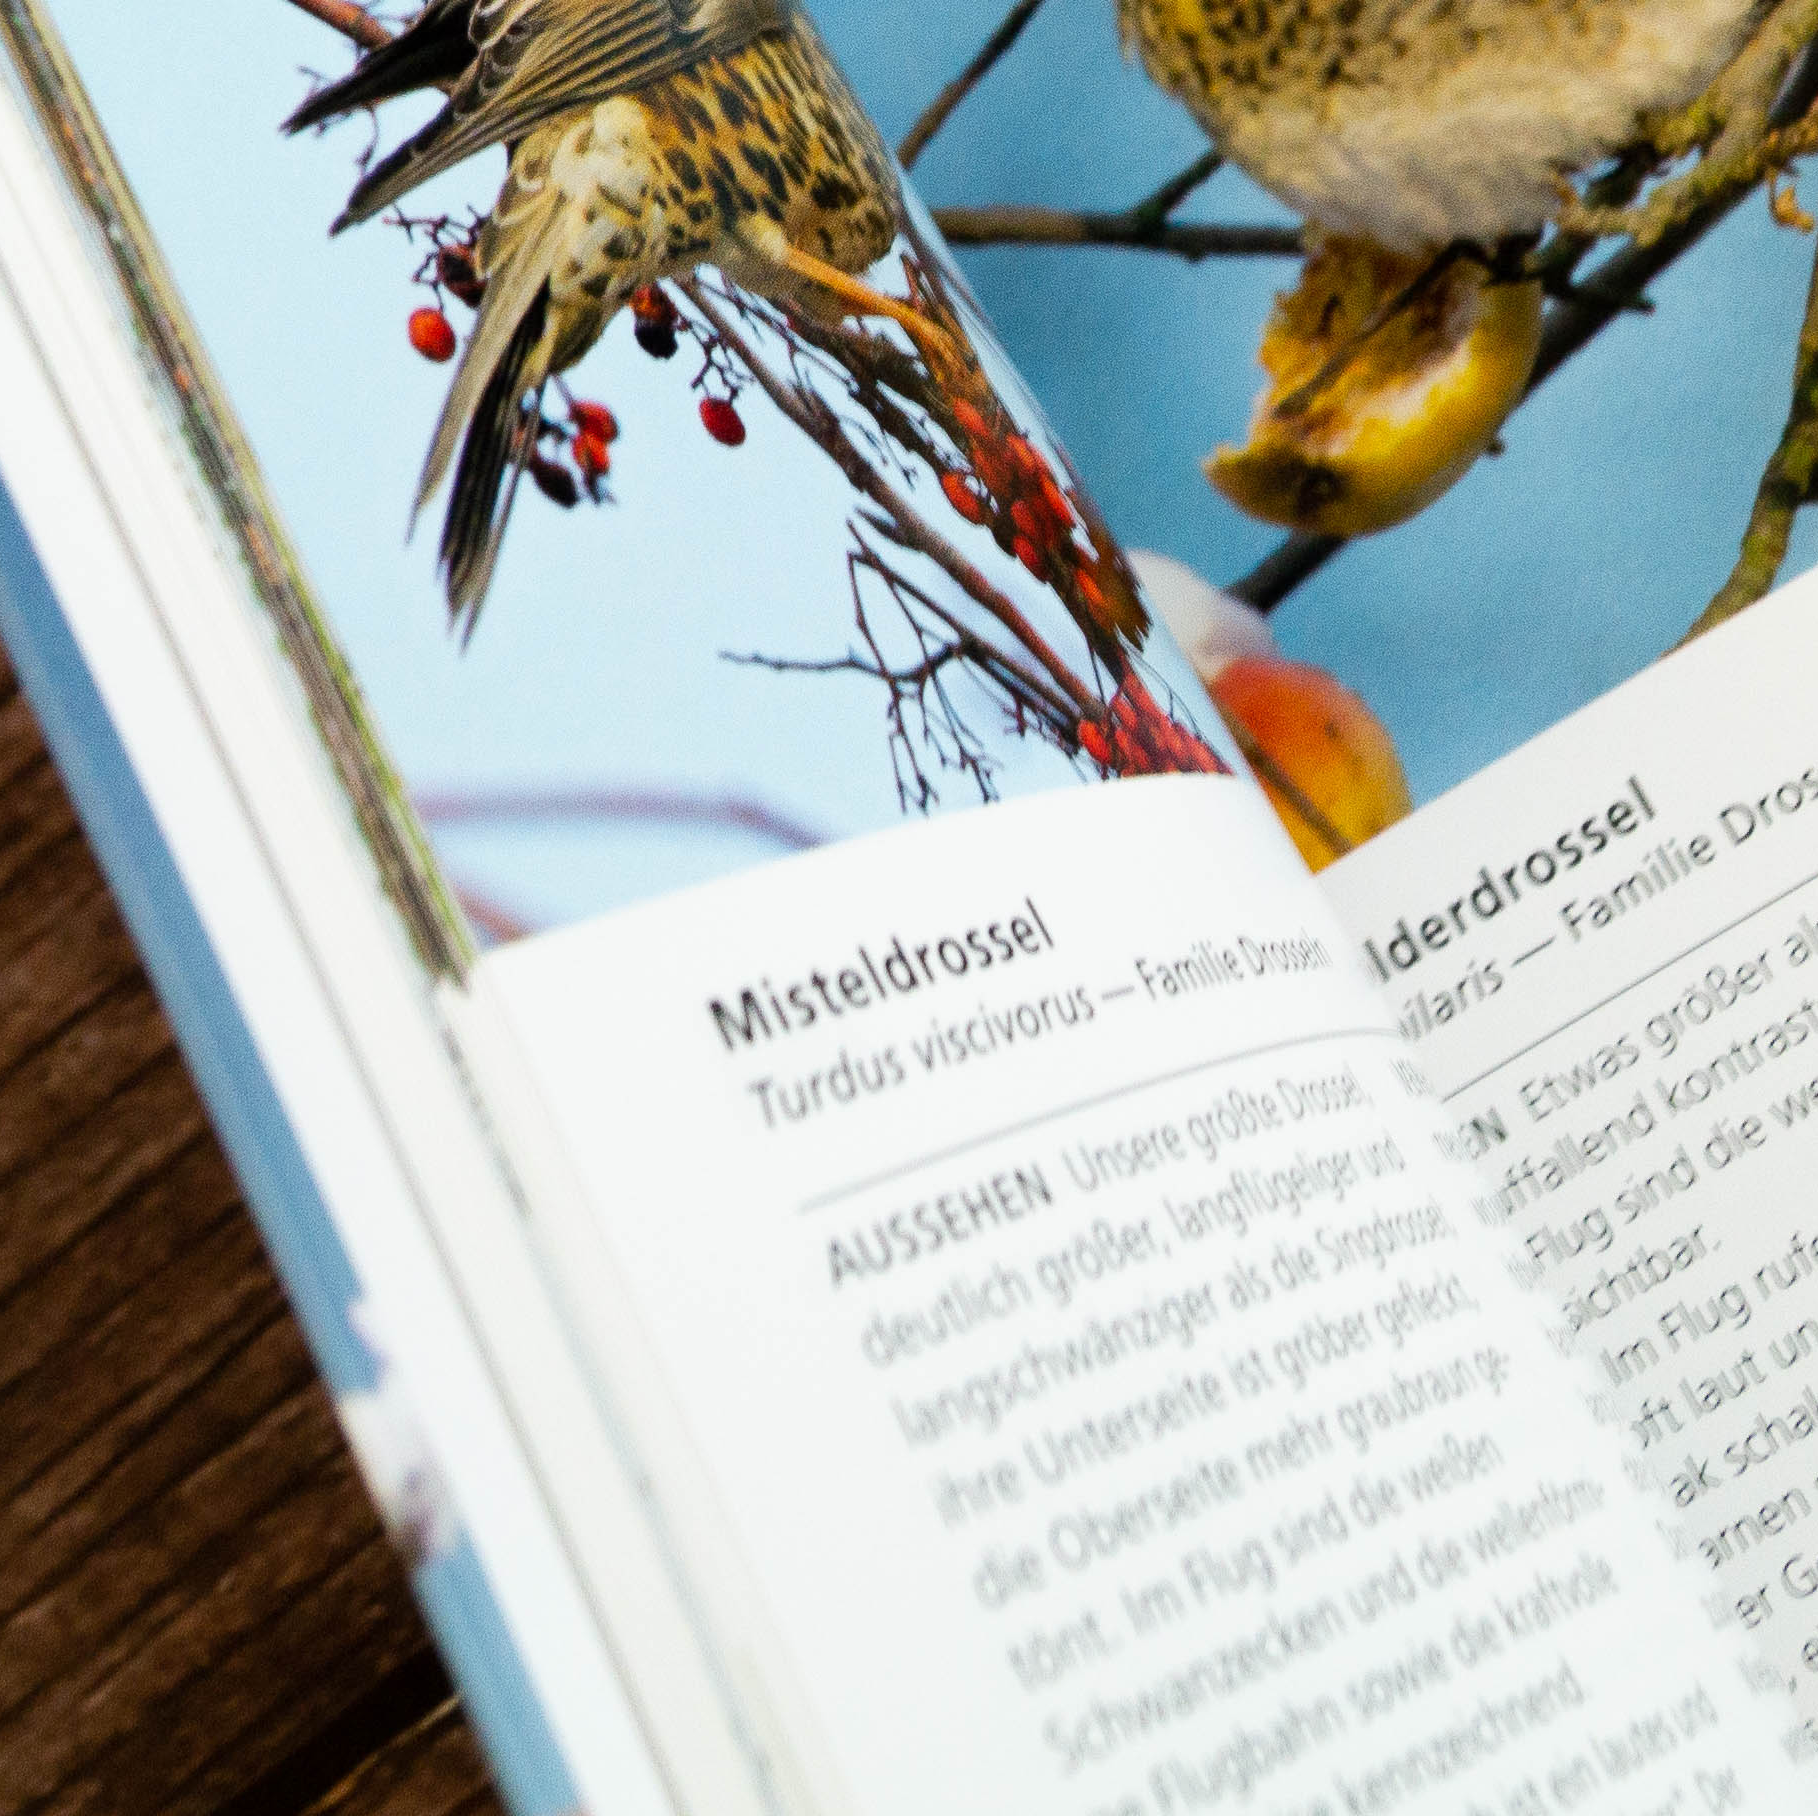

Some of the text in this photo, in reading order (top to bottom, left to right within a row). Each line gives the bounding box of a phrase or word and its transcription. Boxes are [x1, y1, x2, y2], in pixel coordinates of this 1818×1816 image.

[1558, 834, 1717, 943] Familie
[706, 896, 1055, 1052] Misteldrossel
[746, 934, 1329, 1130] Turdus viscivorus Familie Drosseln
[1518, 1033, 1641, 1123] Etwas
[1644, 949, 1774, 1059] größer
[825, 1162, 1056, 1291] AUSSEHEN
[1061, 1123, 1187, 1193] Unsere
[1185, 1087, 1284, 1161] größte
[1274, 1070, 1372, 1122] Drossel,
[1614, 1144, 1700, 1225] sind
[1703, 1115, 1768, 1171] die
[1599, 1337, 1660, 1388] Im
[1657, 1283, 1753, 1353] Flug
[1678, 1349, 1768, 1420] laut
